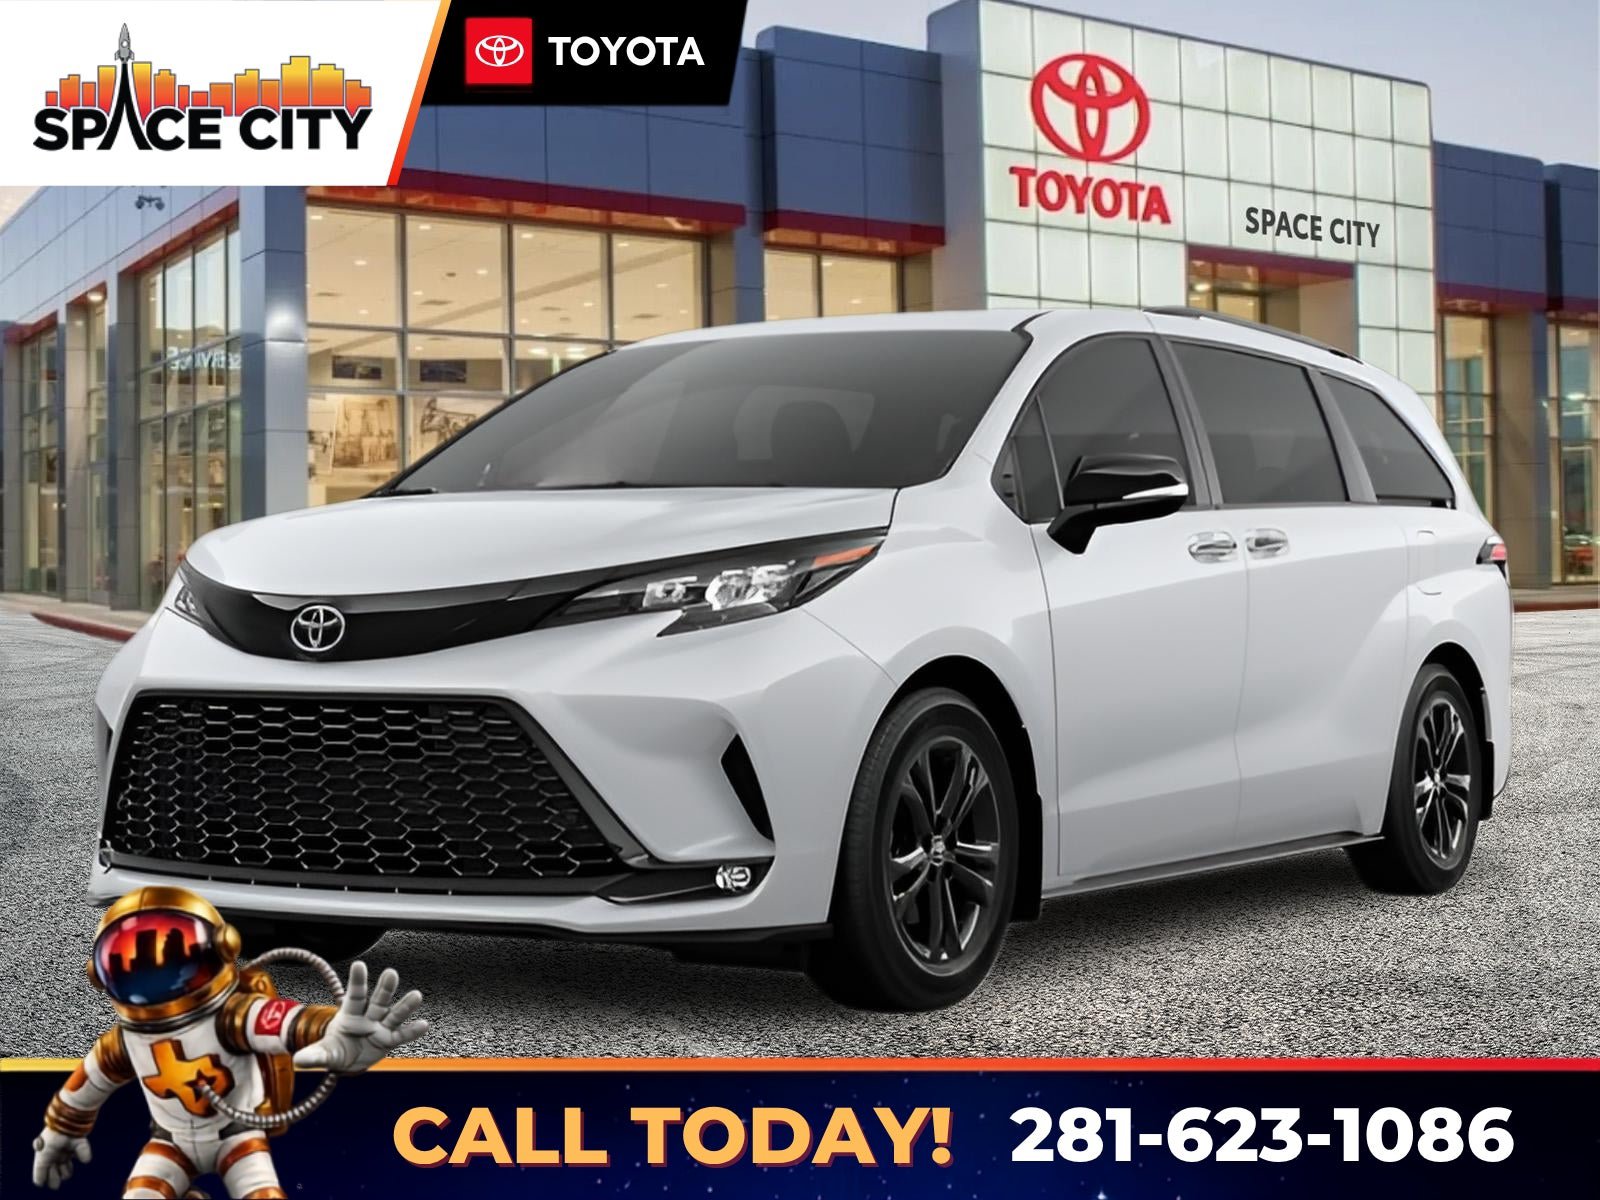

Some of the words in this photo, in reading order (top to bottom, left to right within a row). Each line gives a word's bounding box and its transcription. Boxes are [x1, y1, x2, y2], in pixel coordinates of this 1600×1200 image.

[1009, 166, 1171, 225] TOYOTA
[1245, 207, 1323, 242] SPACE
[1330, 217, 1381, 248] CITY
